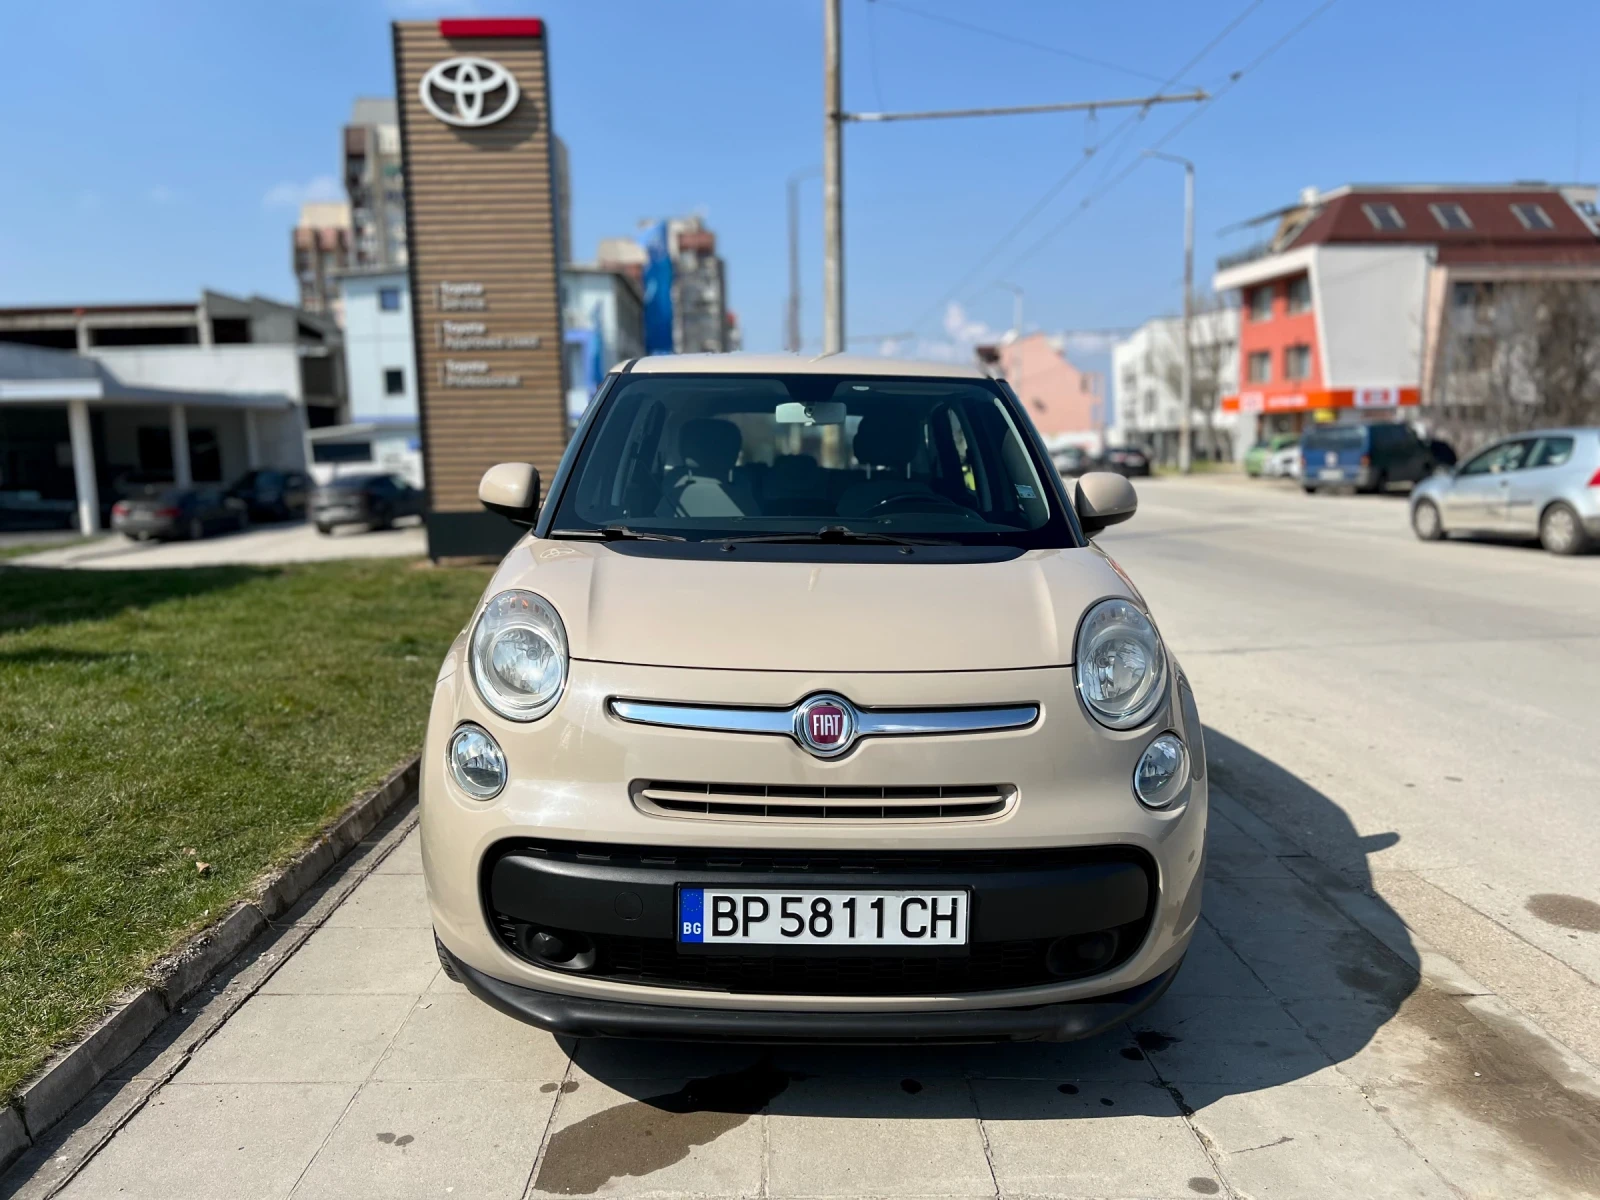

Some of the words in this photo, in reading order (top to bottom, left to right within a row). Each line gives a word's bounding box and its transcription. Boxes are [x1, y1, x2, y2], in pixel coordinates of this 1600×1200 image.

[440, 281, 484, 296] Toyota
[443, 321, 486, 336] Toyota
[446, 359, 489, 374] Toyota
[813, 714, 840, 736] FIAT
[711, 895, 770, 938] BP
[780, 896, 885, 939] 5811
[900, 897, 958, 939] CH
[683, 921, 702, 935] BG
